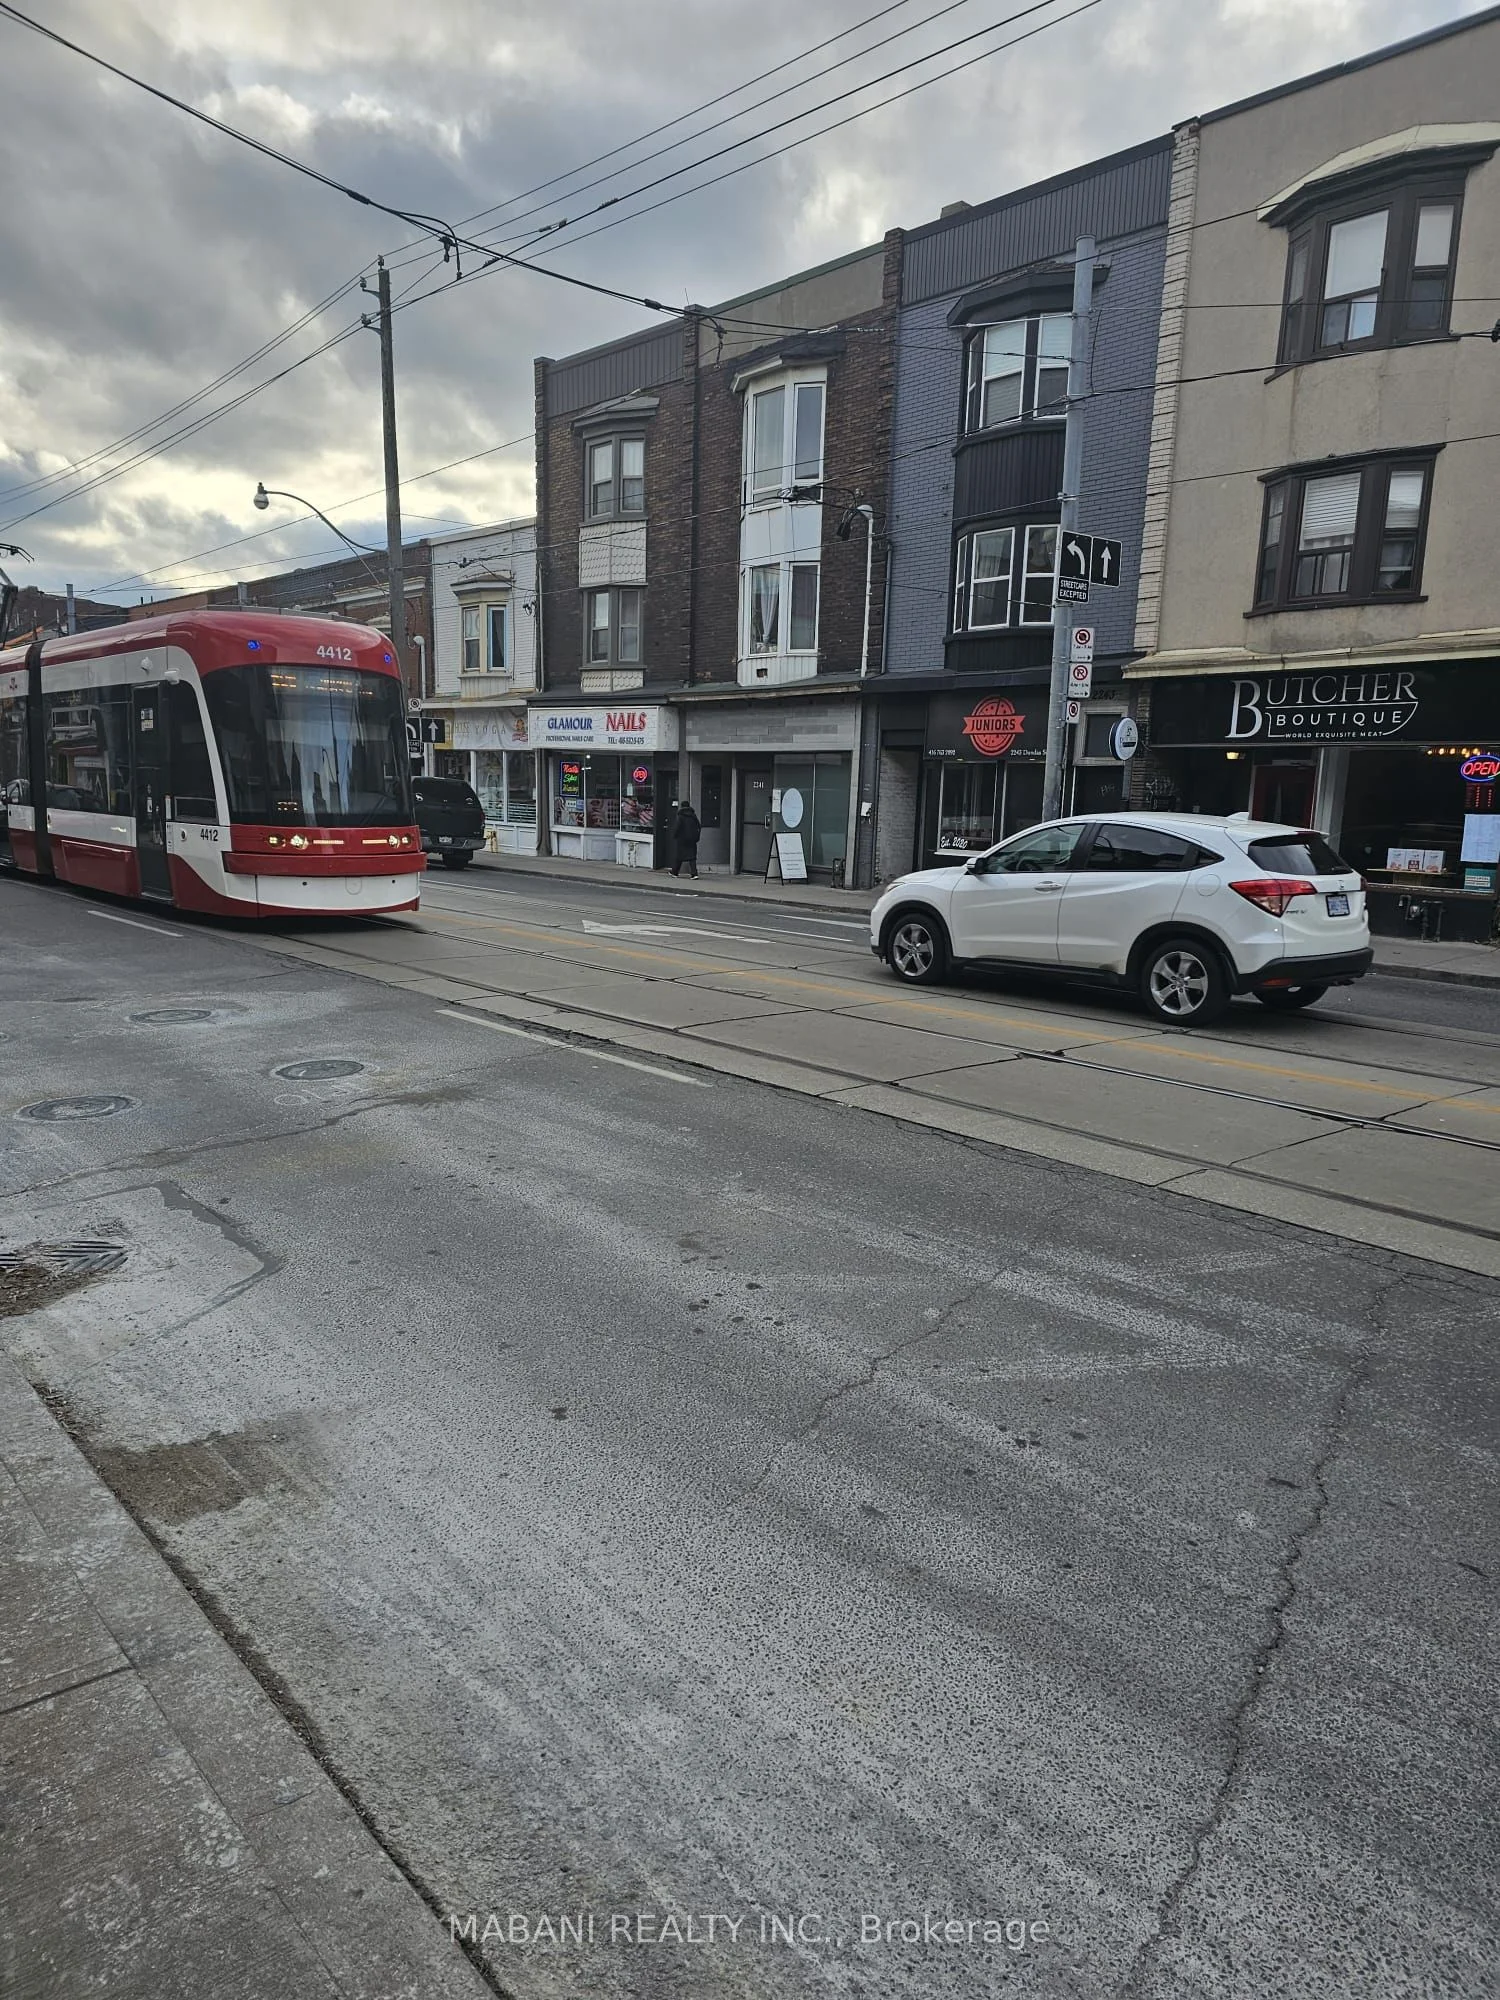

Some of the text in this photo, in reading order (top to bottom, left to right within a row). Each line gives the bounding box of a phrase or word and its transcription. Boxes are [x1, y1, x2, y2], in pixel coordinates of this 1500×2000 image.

[1060, 580, 1088, 590] STREETCARS
[1059, 590, 1087, 600] EXCEPTED
[316, 645, 352, 661] 4412
[1225, 672, 1418, 738] BUTCHER
[547, 712, 647, 732] GLAMOUR NAILS
[971, 718, 1016, 731] JUNIORS
[1276, 711, 1402, 727] BOUTIQUE
[475, 724, 506, 735] YOGA
[1462, 762, 1500, 775] OPEN
[200, 828, 218, 842] 4412
[952, 836, 968, 849] 2020
